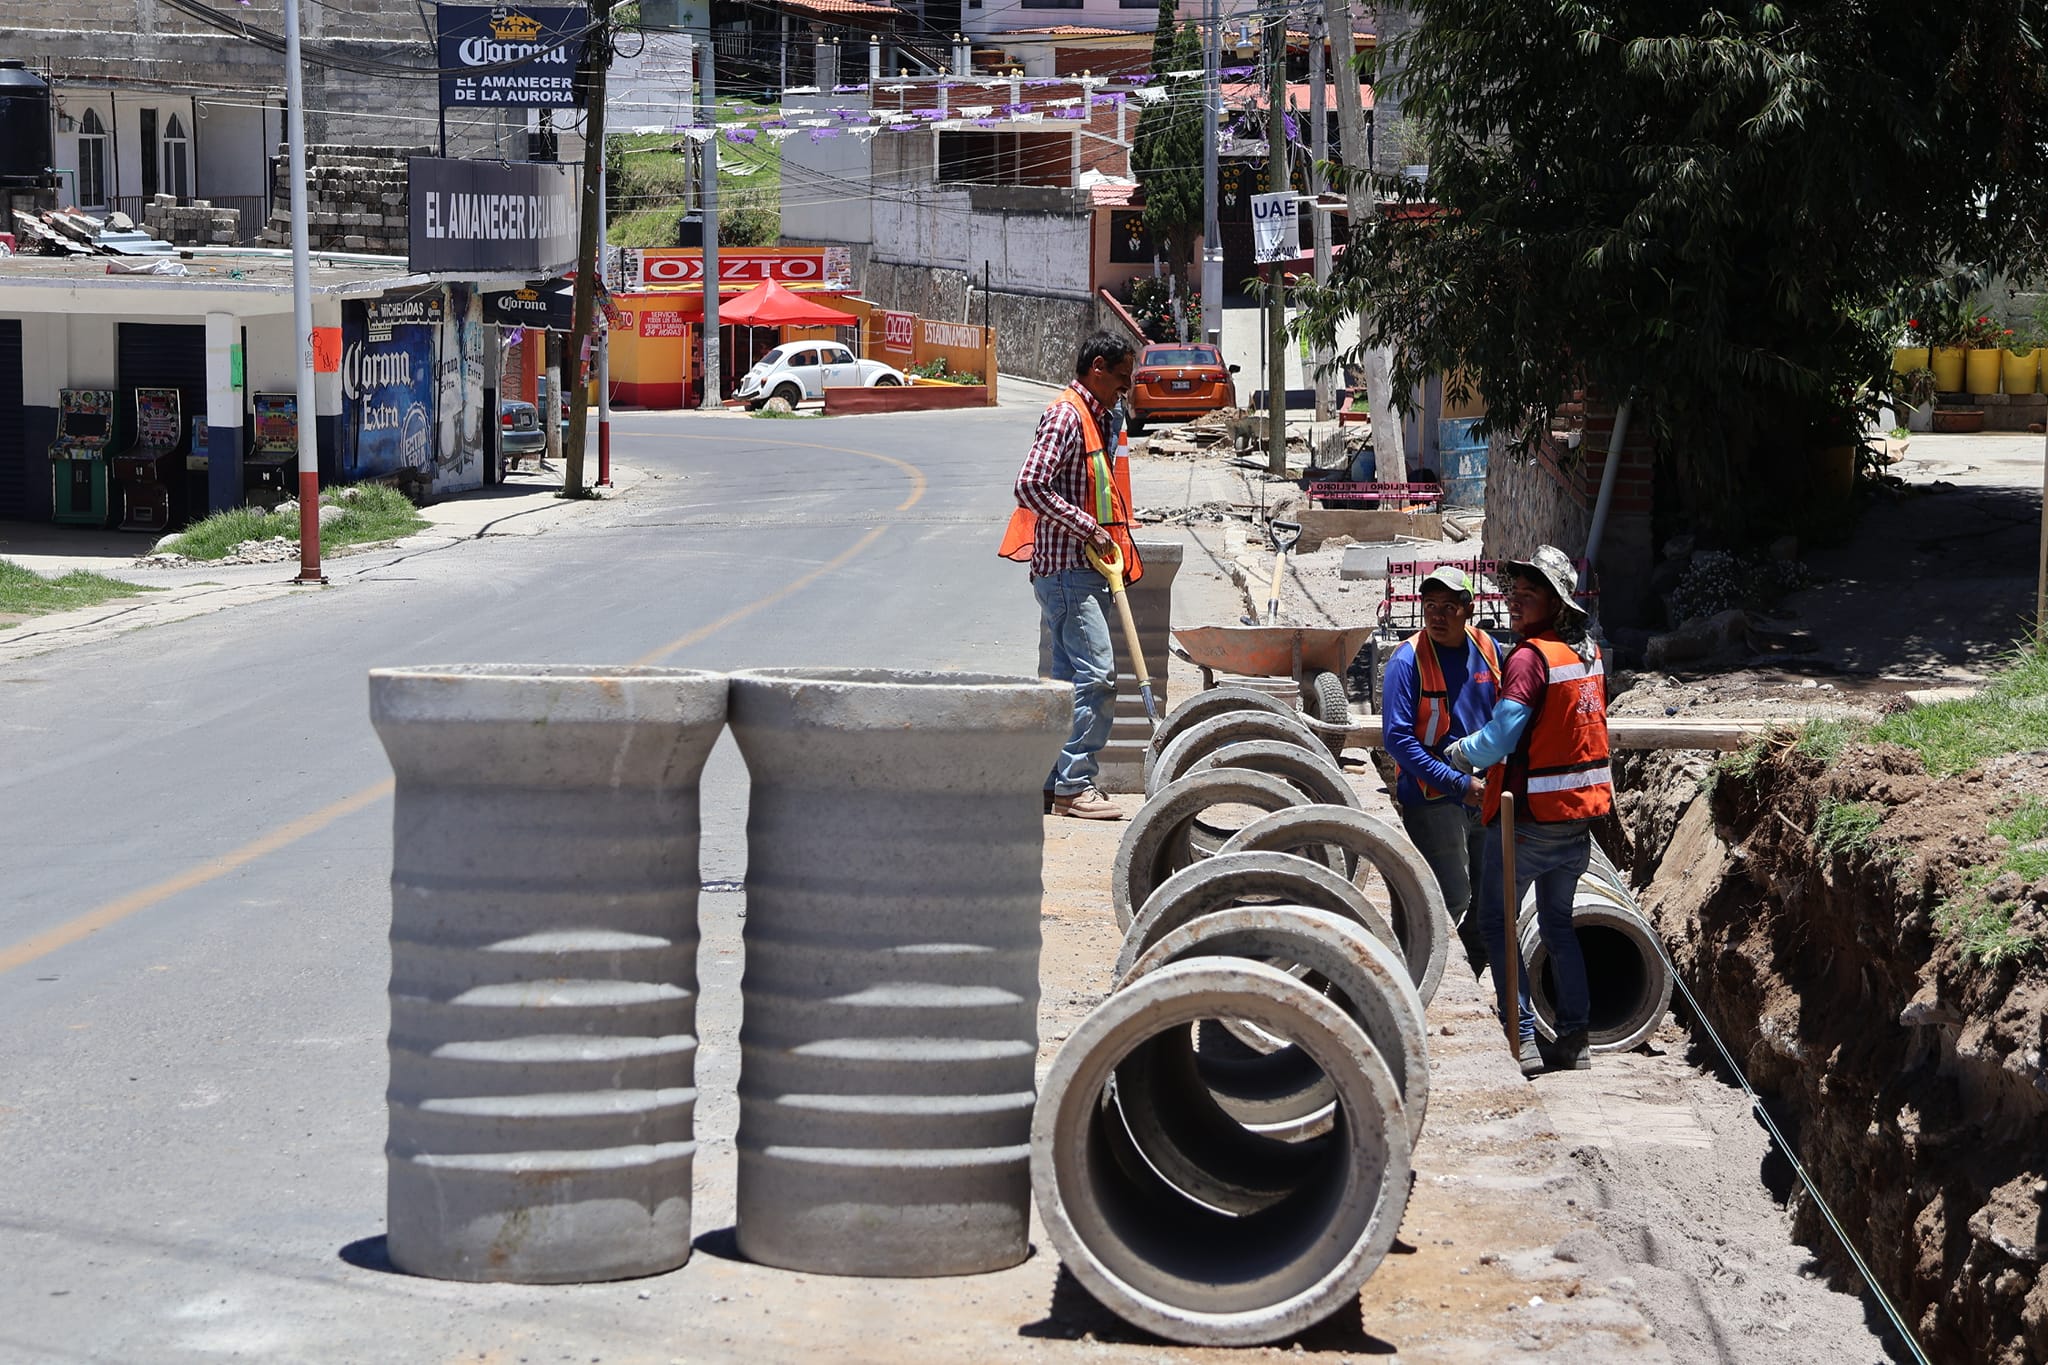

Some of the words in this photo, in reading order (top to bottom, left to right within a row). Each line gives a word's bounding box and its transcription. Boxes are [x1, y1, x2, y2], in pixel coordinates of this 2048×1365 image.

[459, 36, 568, 66] Corona
[457, 77, 476, 87] EL
[481, 76, 573, 88] AMANECER
[455, 89, 476, 100] DE
[481, 90, 502, 101] LA
[507, 90, 574, 102] AURORA
[426, 192, 445, 239] EL
[448, 193, 526, 240] AMANECER
[529, 195, 542, 240] DE
[1254, 200, 1296, 219] UAE
[380, 302, 424, 318] MICHELADAS
[498, 296, 547, 311] Corona
[658, 328, 682, 337] HORAS
[343, 340, 412, 400] Corona
[363, 393, 399, 431] Extra
